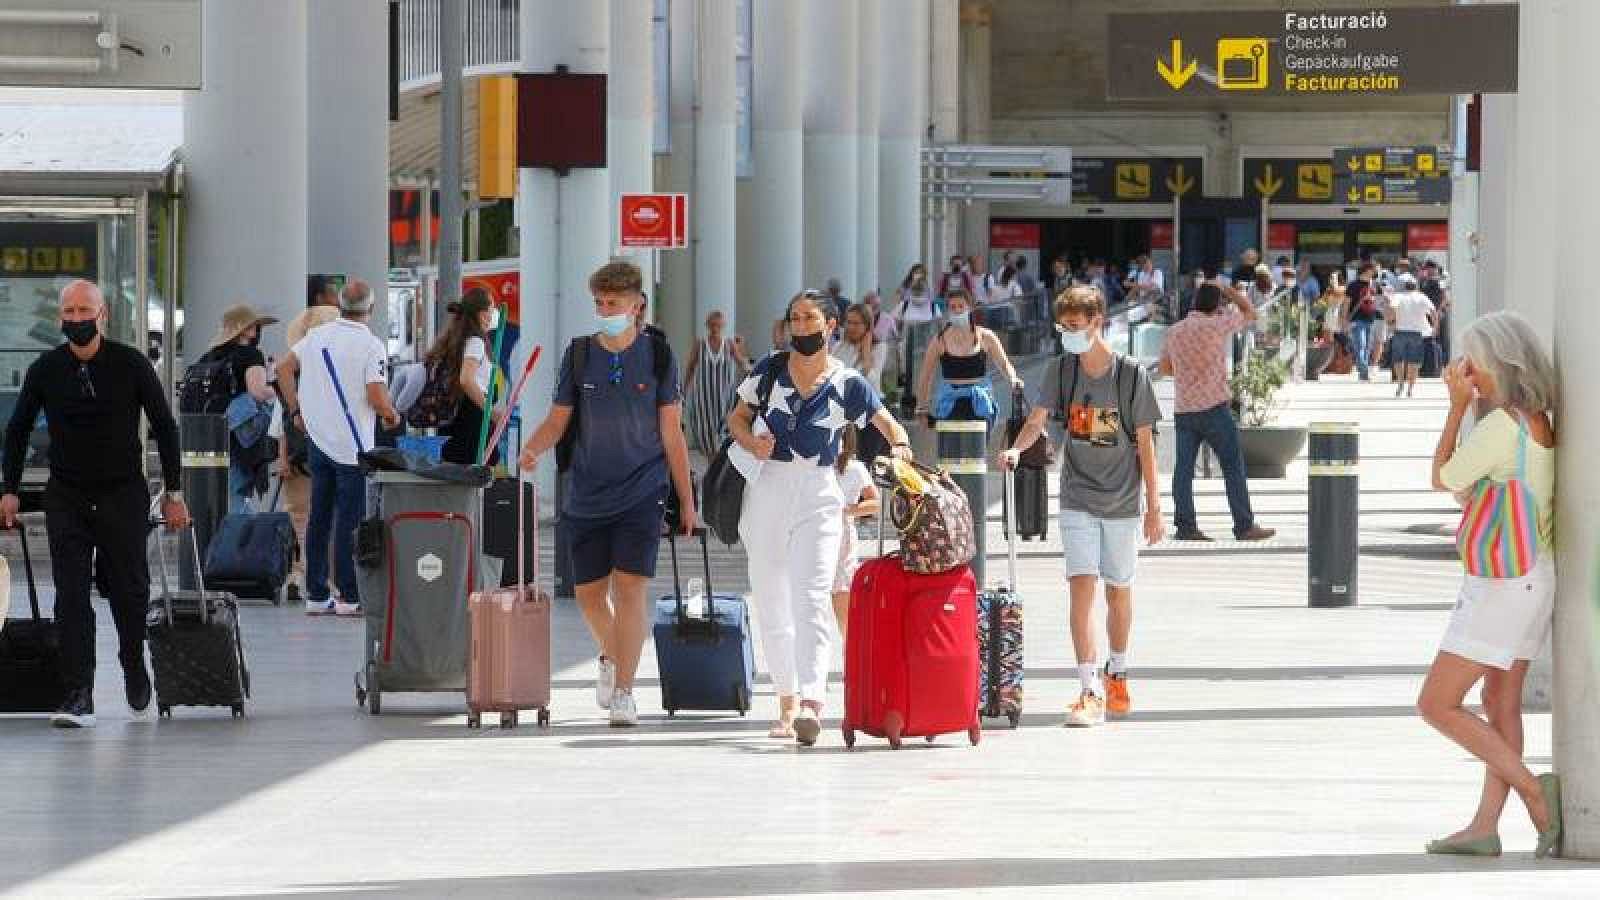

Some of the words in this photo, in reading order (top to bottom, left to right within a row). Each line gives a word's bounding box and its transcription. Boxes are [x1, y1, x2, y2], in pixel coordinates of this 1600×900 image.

[1286, 10, 1387, 30] Facturació
[1286, 34, 1346, 50] Check-in
[1286, 72, 1399, 90] Facturación
